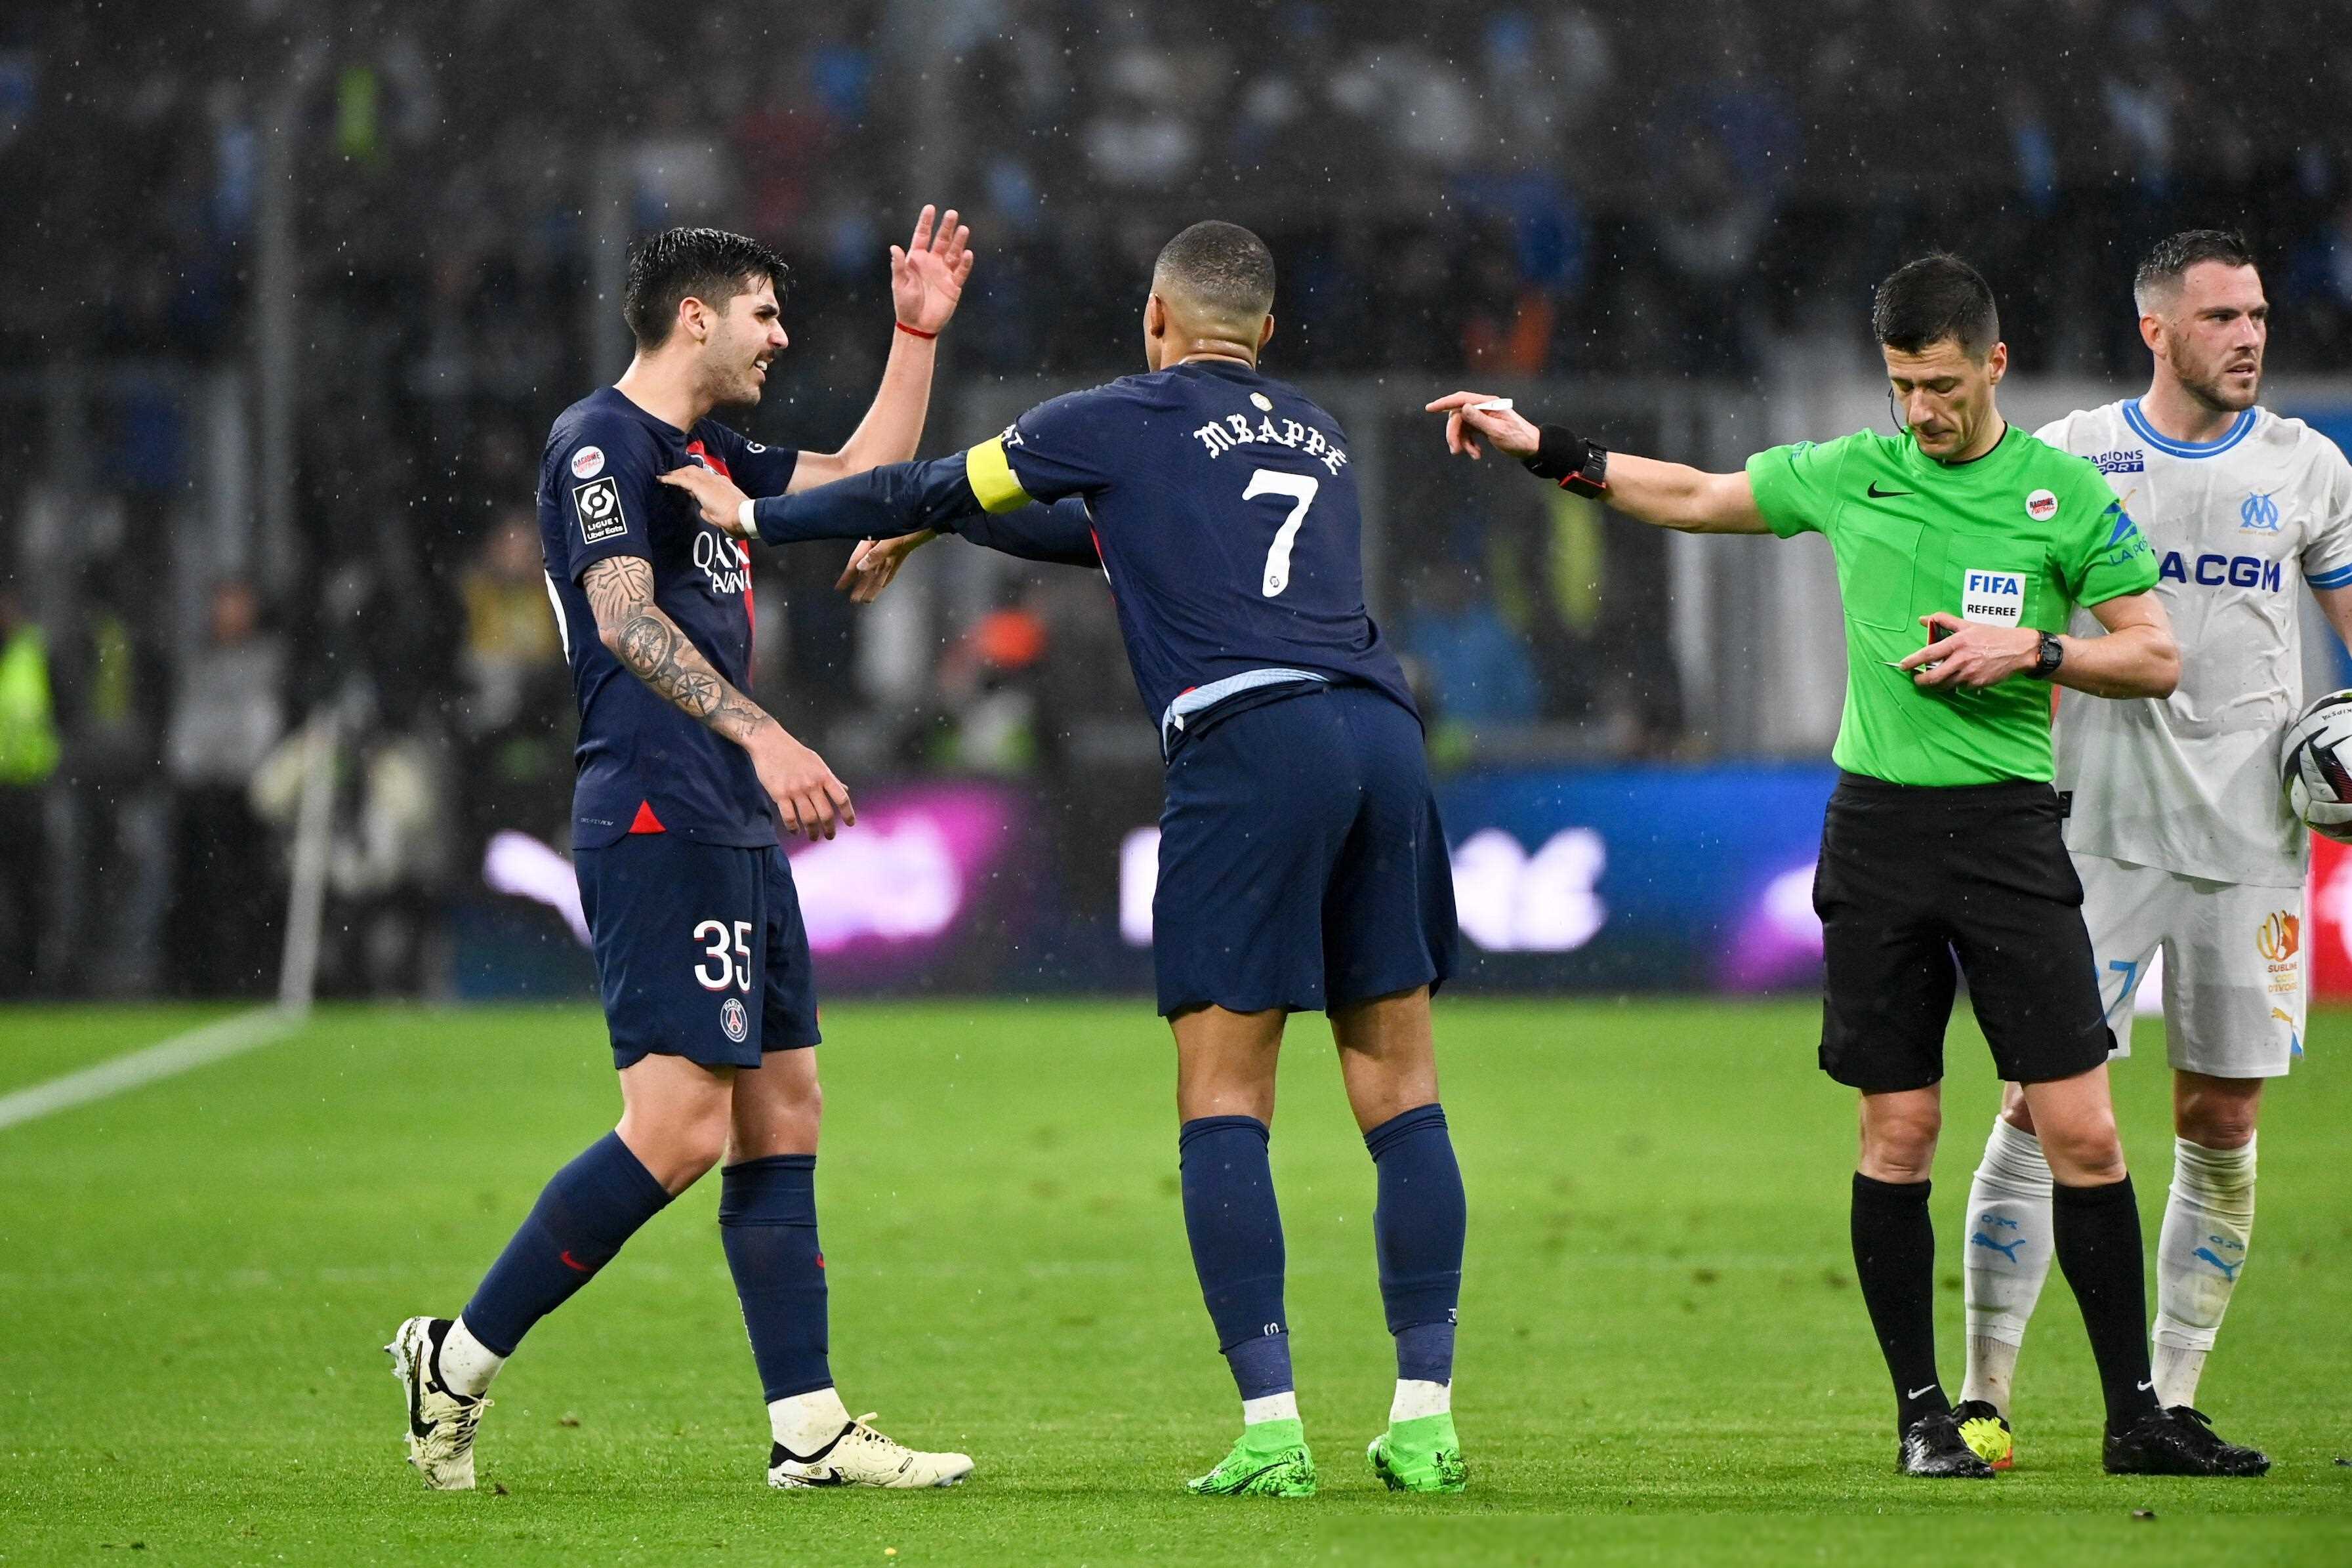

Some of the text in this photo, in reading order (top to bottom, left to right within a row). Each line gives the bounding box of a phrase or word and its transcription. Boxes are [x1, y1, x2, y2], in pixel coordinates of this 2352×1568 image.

[2082, 449, 2143, 464] ARIONS
[2099, 462, 2141, 472] PORT
[588, 518, 613, 531] LIGUE
[587, 525, 624, 540] Uber Eats
[1242, 468, 1319, 598] 7
[2109, 550, 2134, 566] LA
[1970, 574, 2019, 595] FIFA
[1968, 604, 2017, 617] REFEREE
[693, 920, 752, 993] 35
[724, 1001, 741, 1012] PARIS
